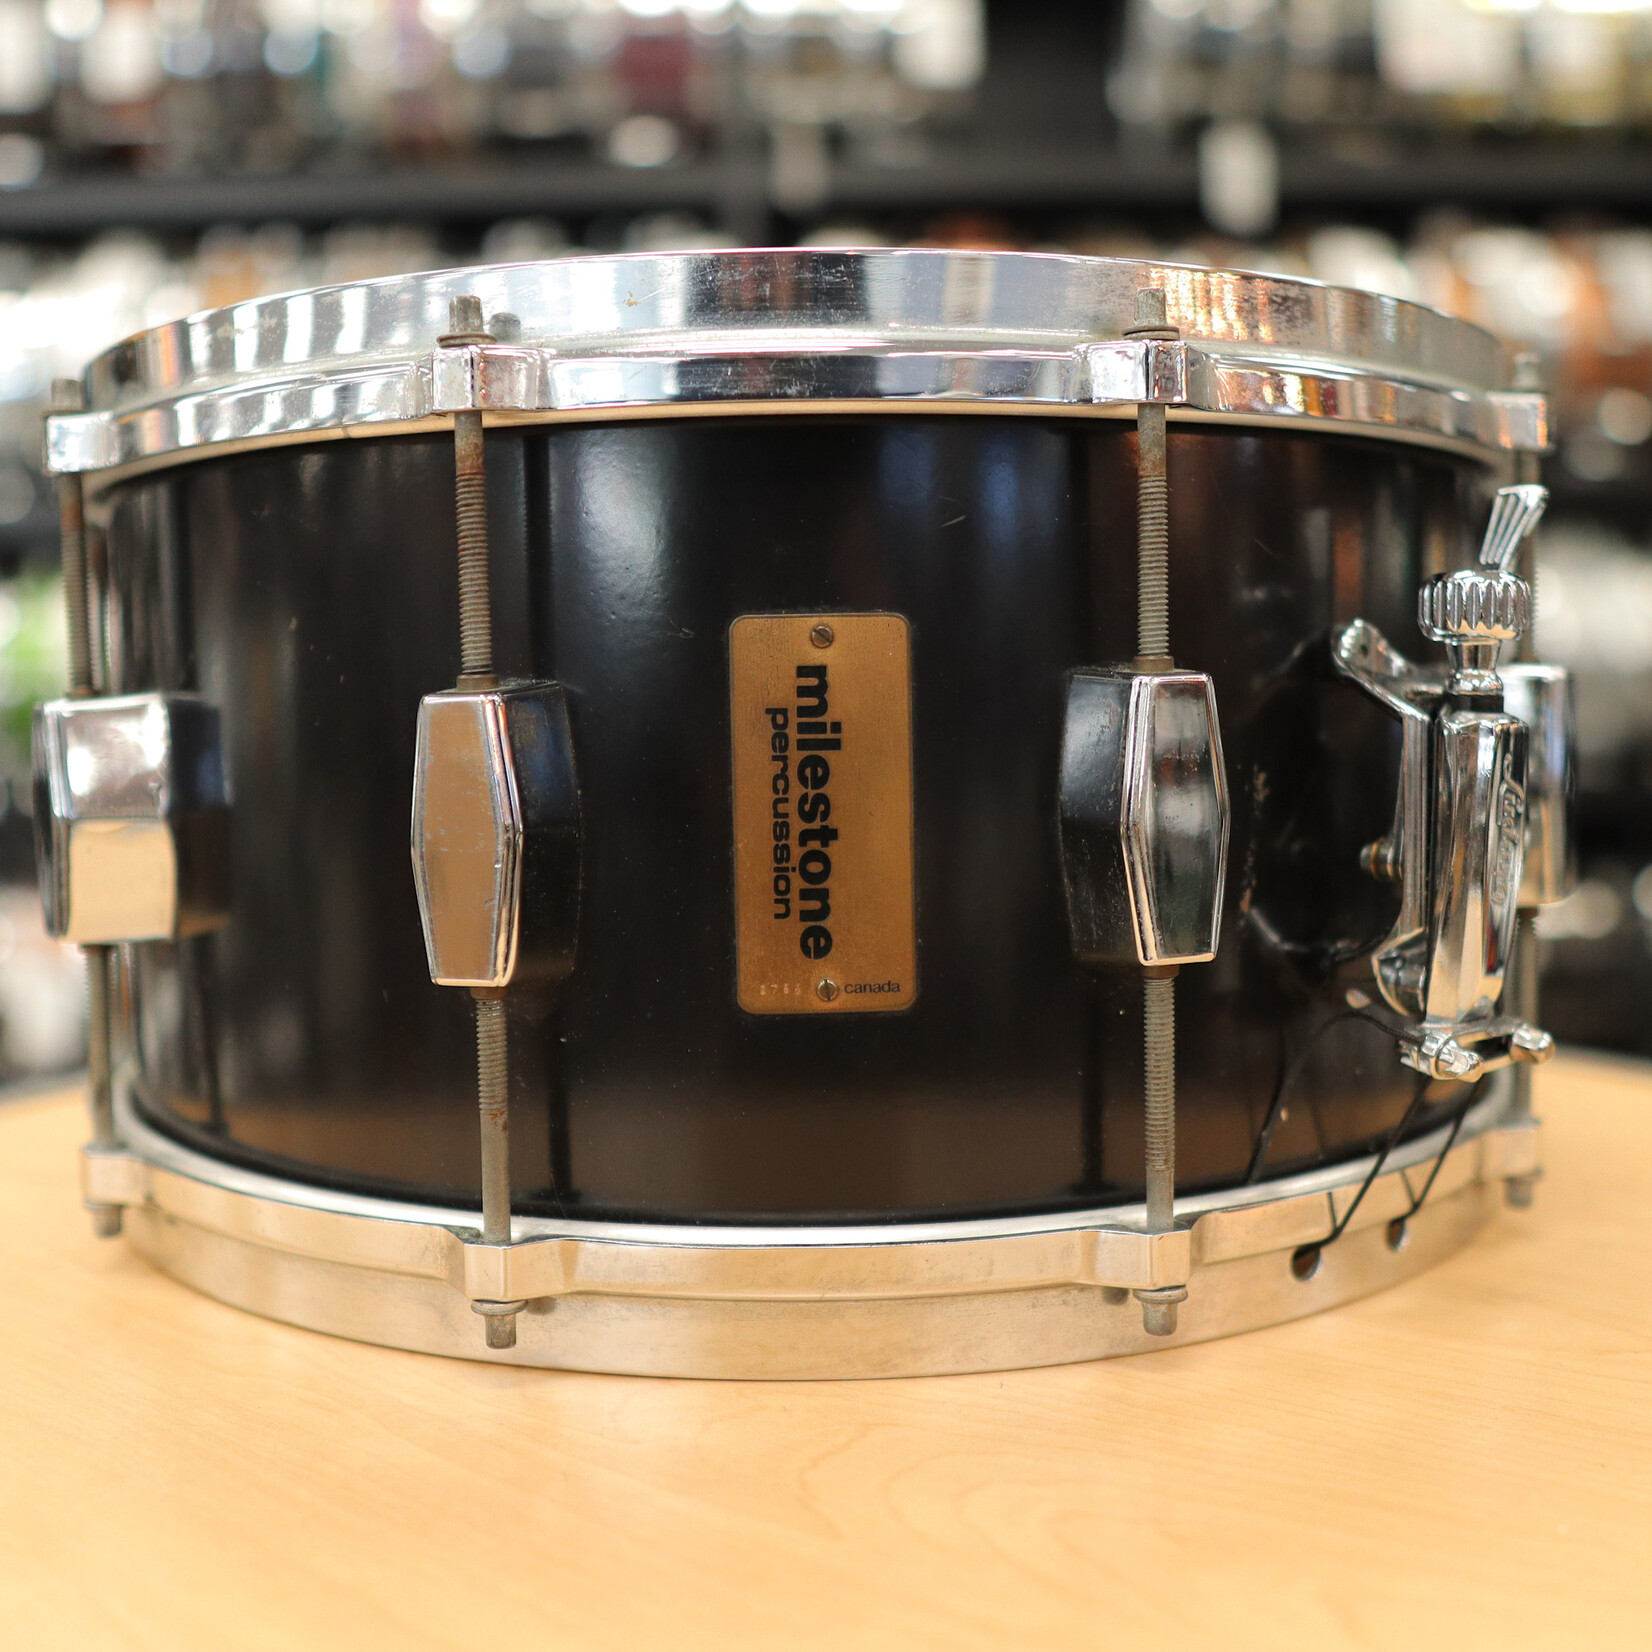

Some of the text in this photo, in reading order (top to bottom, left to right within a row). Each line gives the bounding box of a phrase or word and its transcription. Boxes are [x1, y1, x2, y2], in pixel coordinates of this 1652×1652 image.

[764, 707, 796, 920] percussion
[796, 664, 843, 960] milestone
[844, 980, 901, 994] canada
